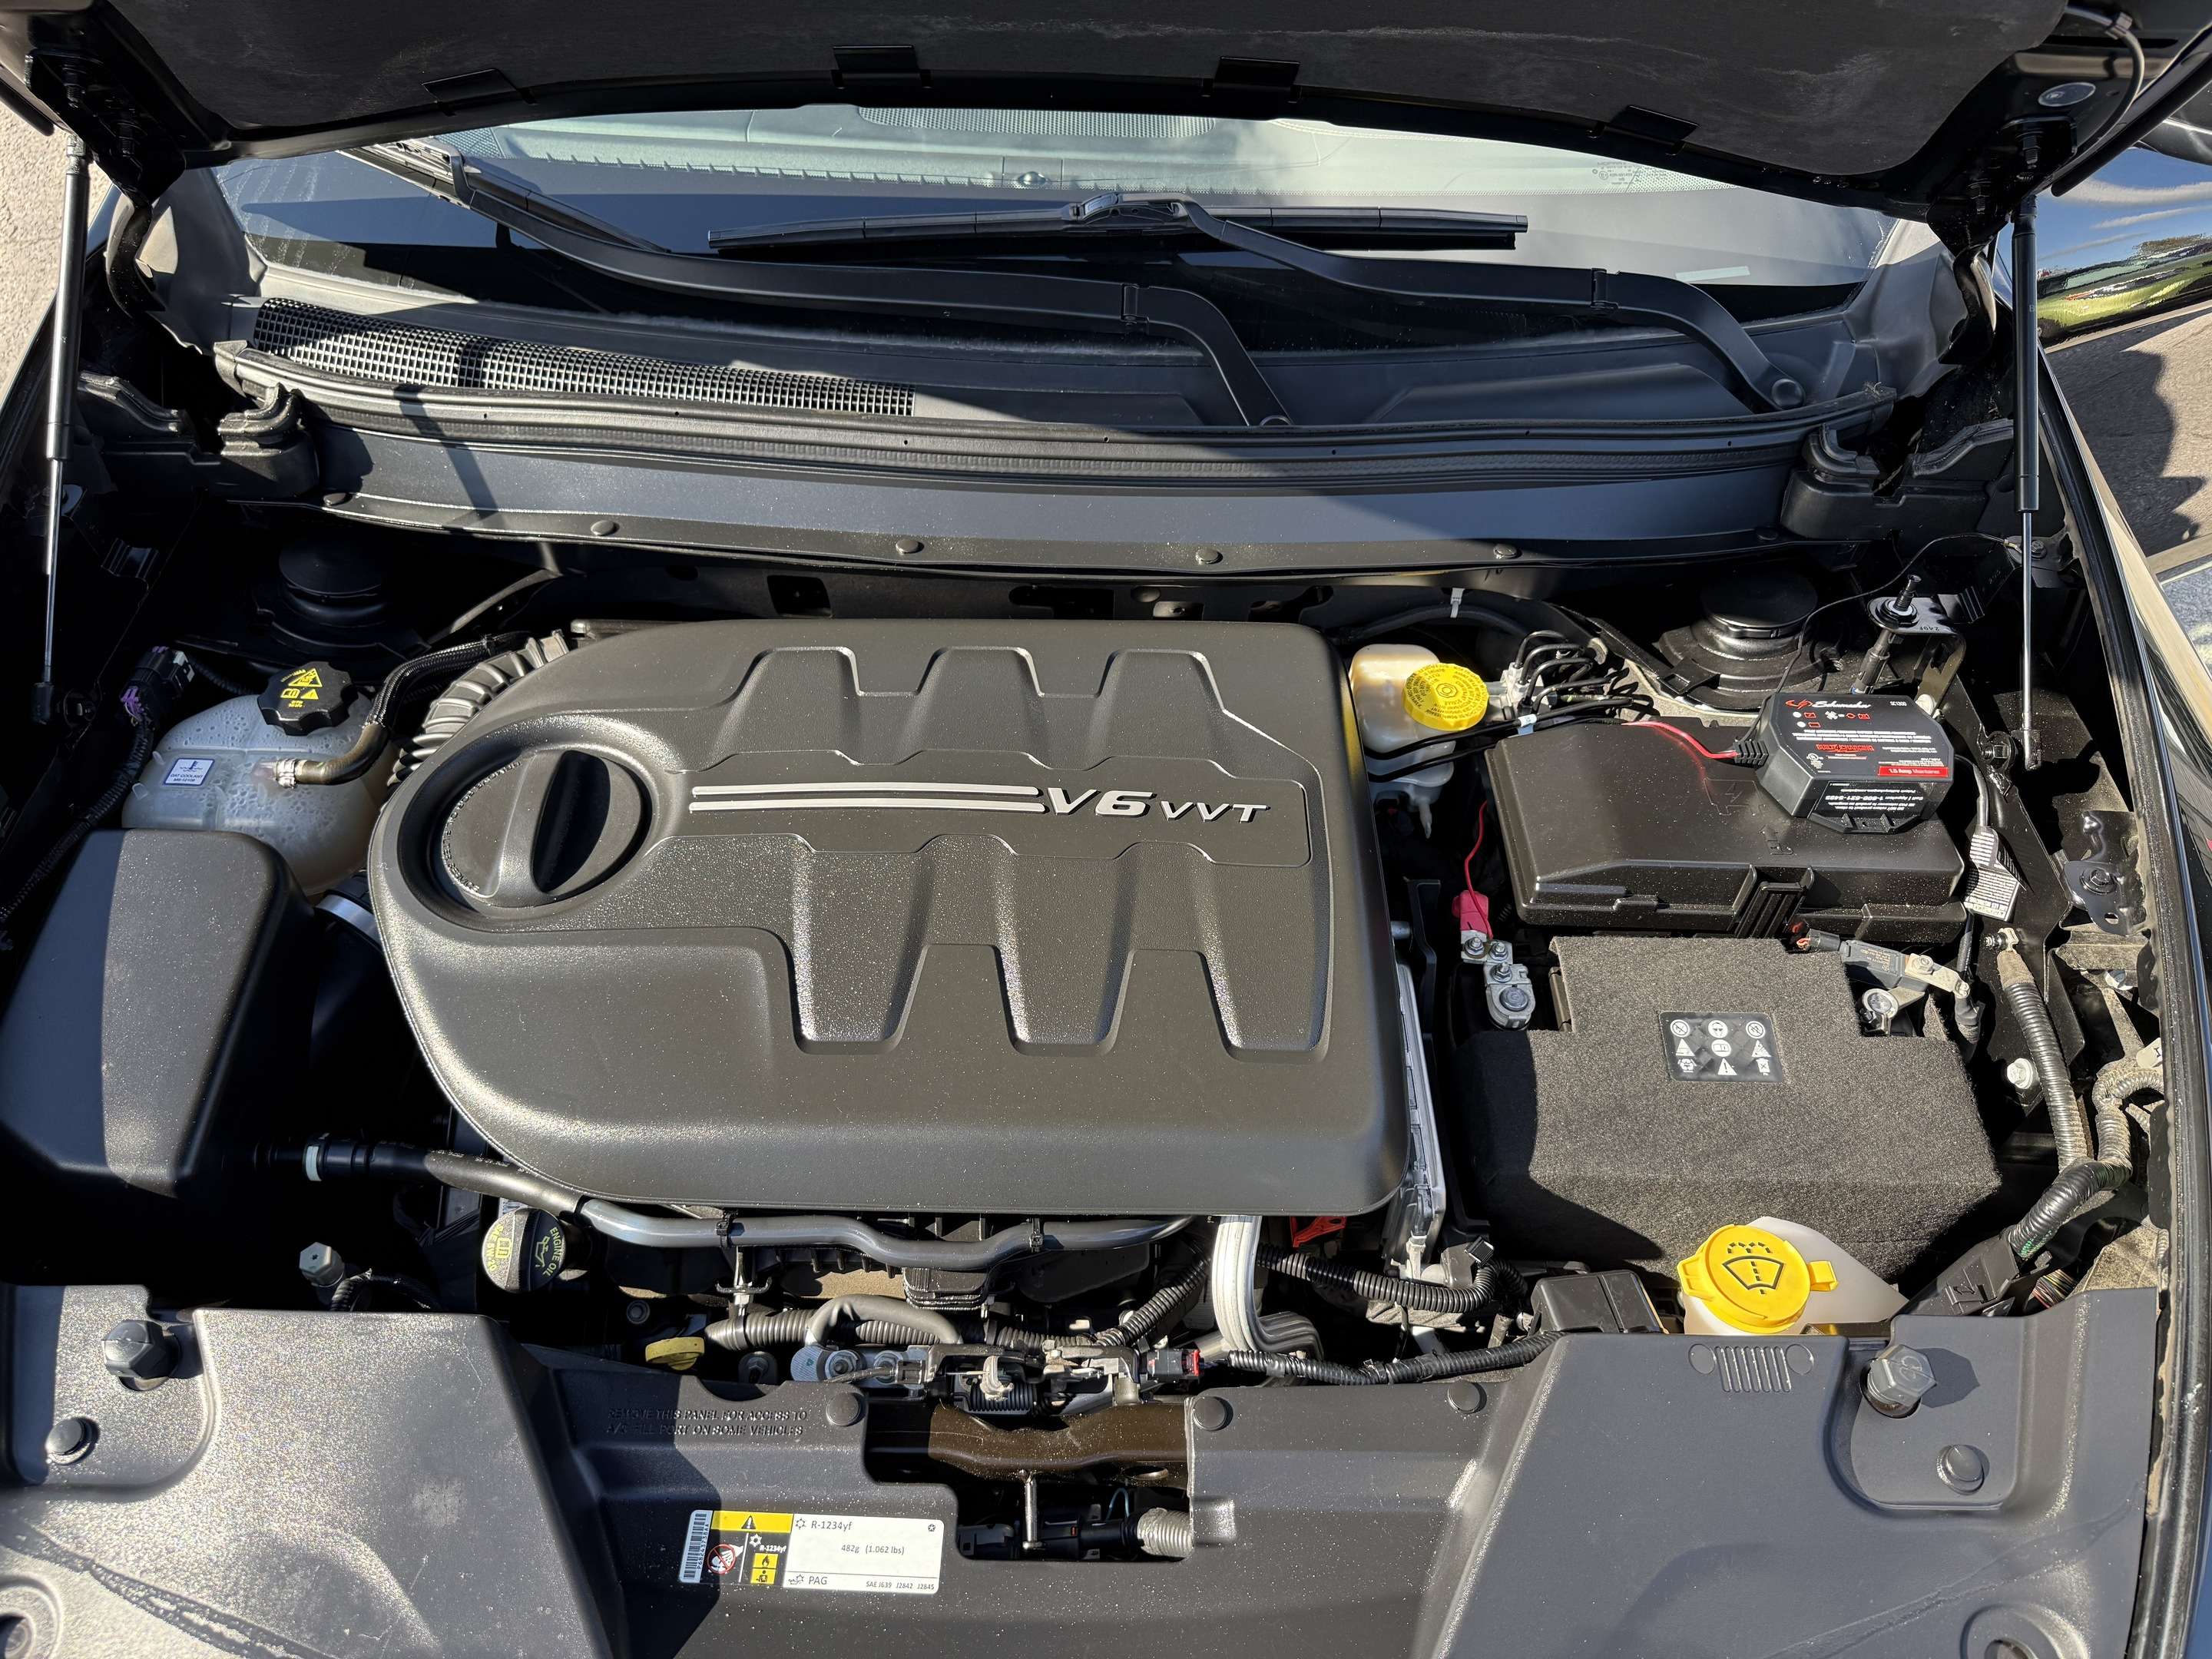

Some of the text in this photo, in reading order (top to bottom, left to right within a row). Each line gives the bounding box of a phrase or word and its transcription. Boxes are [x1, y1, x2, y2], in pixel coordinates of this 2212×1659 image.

[1048, 787, 1268, 823] V6 VVT
[448, 863, 480, 893] SERVICE
[492, 1224, 504, 1241] SAE
[542, 1227, 562, 1277] ENGINE OIL
[655, 1409, 682, 1420] THIS
[683, 1410, 719, 1421] PANEL
[721, 1410, 744, 1421] FOR
[745, 1410, 790, 1421] ACCESS
[793, 1410, 807, 1420] TO
[659, 1423, 690, 1435] PORT
[693, 1424, 711, 1435] ON
[712, 1424, 747, 1435] SOME
[750, 1425, 803, 1435] VEHICLES
[811, 1520, 853, 1532] R-1234yf
[841, 1545, 905, 1555] 482g (1.062 lbs)
[808, 1577, 828, 1586] PAG
